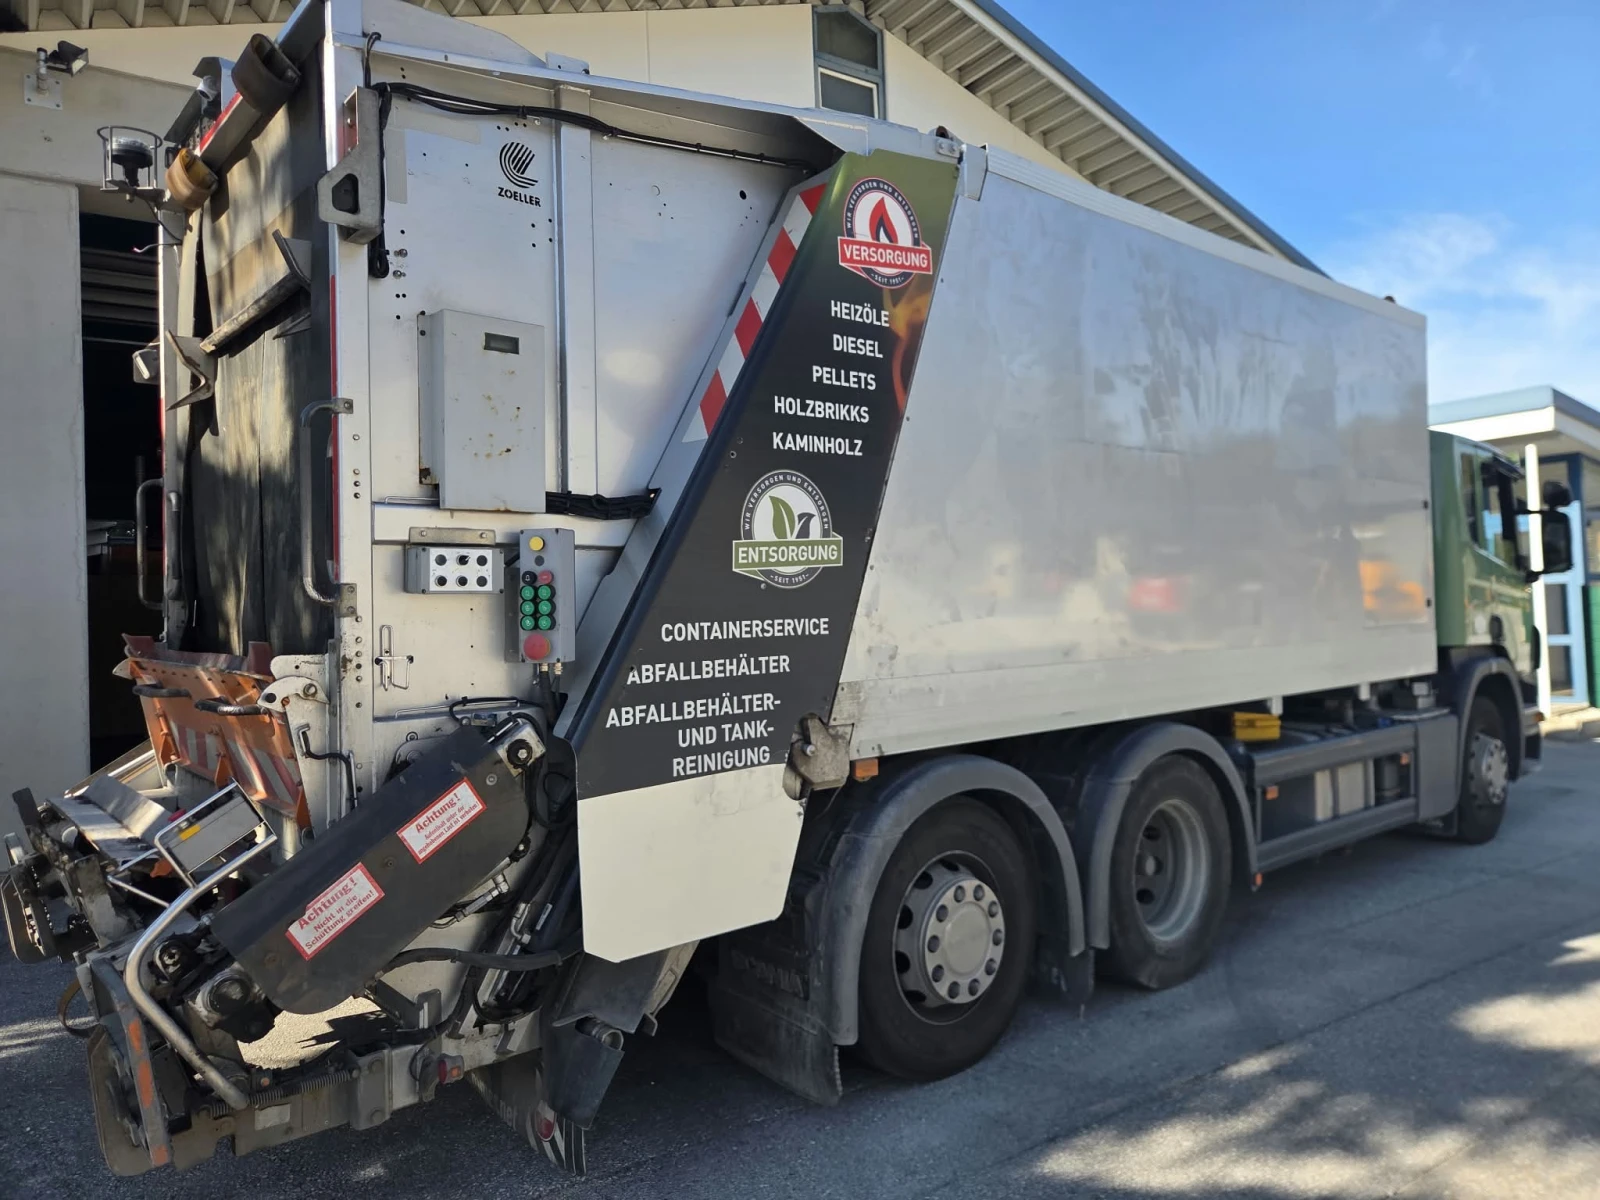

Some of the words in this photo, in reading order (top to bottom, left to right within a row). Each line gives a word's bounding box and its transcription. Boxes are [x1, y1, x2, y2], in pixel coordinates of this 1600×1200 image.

[498, 187, 541, 207] ZOELLER
[843, 244, 928, 268] VERSORGUNG
[831, 300, 890, 327] HEIZÖLE
[833, 334, 883, 358] DIESEL
[812, 365, 876, 390] PELLETS
[774, 395, 869, 423] HOLZBRIKKS
[772, 432, 863, 456] KAMINHOLZ
[748, 474, 784, 508] VERSORGEN
[786, 475, 802, 484] UND
[803, 481, 829, 529] ENTSORGEN
[738, 544, 838, 564] ENTSORGUNG
[661, 618, 829, 642] CONTAINERSERVICE
[627, 653, 790, 685] ABFALLBEHÄLTER
[605, 692, 781, 728] ABFALLBEHÄLTER-
[678, 726, 717, 748] UND
[721, 719, 774, 742] TANK-
[672, 745, 770, 777] REINIGUNG
[313, 912, 336, 932] Nicht
[336, 906, 345, 914] in
[345, 894, 358, 906] die
